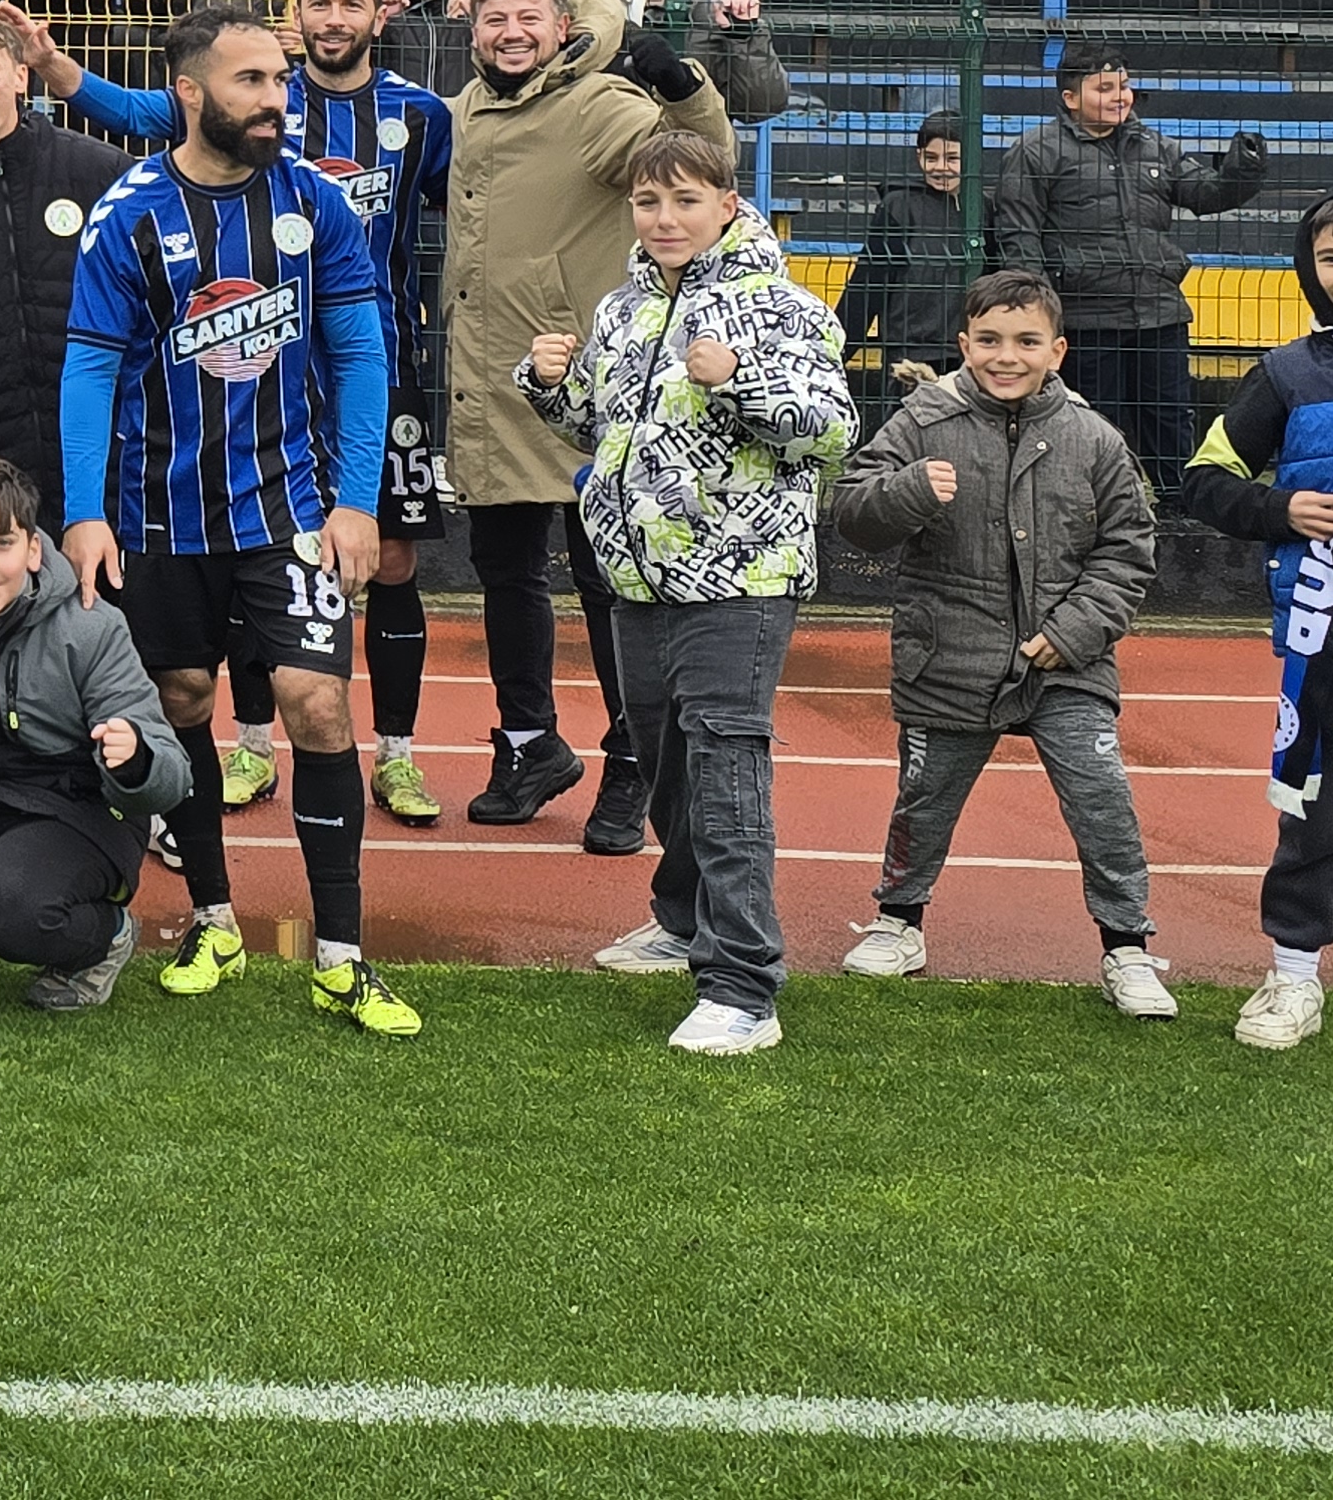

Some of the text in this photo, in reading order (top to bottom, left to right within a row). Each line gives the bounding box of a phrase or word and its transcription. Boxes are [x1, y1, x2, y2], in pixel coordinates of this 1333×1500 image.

[353, 198, 386, 216] OLA
[176, 287, 295, 354] SARIYER
[243, 320, 298, 358] KOLA
[388, 447, 433, 496] 15
[286, 563, 346, 621] 18
